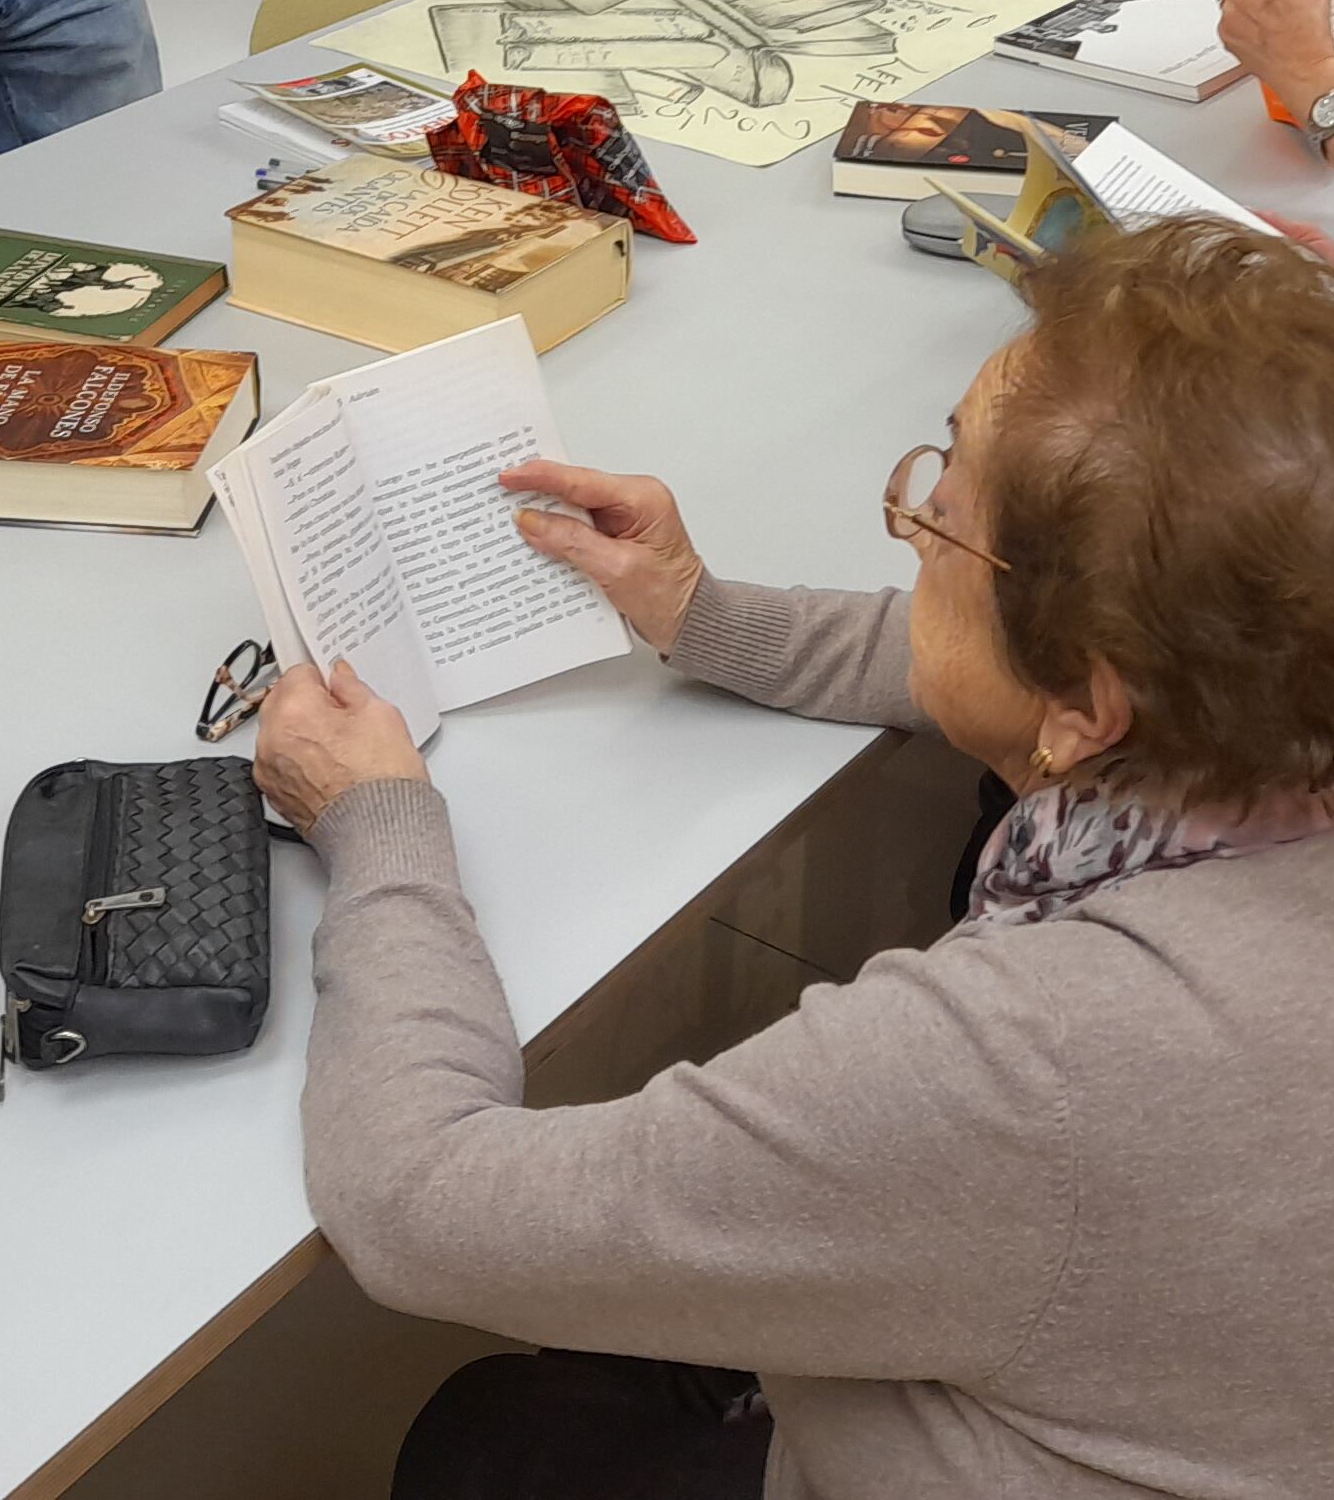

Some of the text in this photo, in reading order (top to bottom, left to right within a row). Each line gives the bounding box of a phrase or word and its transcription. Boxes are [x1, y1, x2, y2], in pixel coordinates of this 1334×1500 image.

[312, 169, 412, 214] GIGANTES
[378, 175, 495, 241] FOLLETT
[399, 189, 429, 201] LA
[443, 197, 513, 230] KEN
[0, 364, 24, 380] DE
[18, 370, 43, 385] LA
[50, 365, 116, 438] FALCONES
[79, 372, 132, 433] ILDEFONSO
